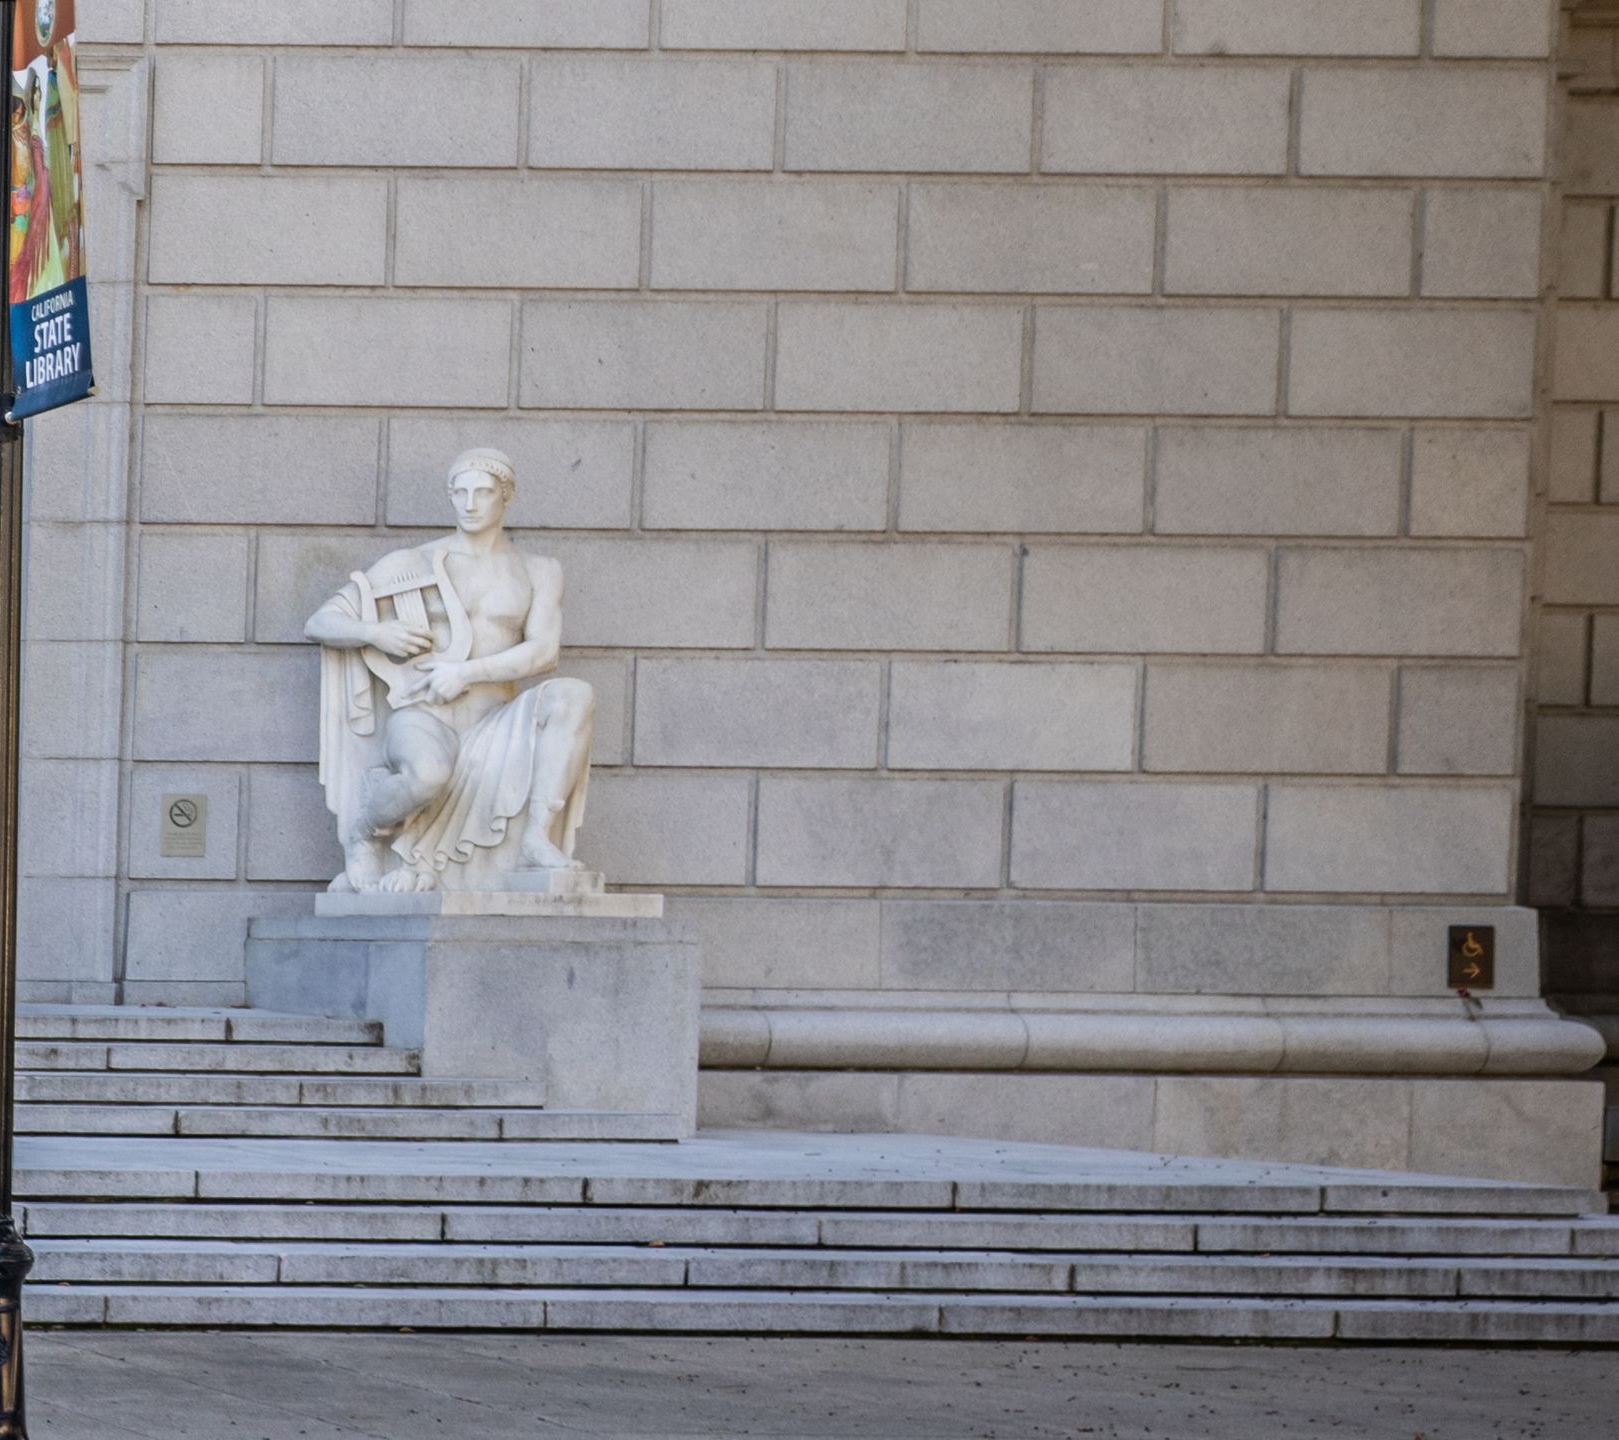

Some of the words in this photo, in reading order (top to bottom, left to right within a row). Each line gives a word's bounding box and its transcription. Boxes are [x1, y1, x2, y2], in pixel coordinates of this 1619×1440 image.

[32, 290, 74, 322] CALIFORNIA
[34, 312, 72, 354] STATE
[25, 342, 81, 389] LIBRARY
